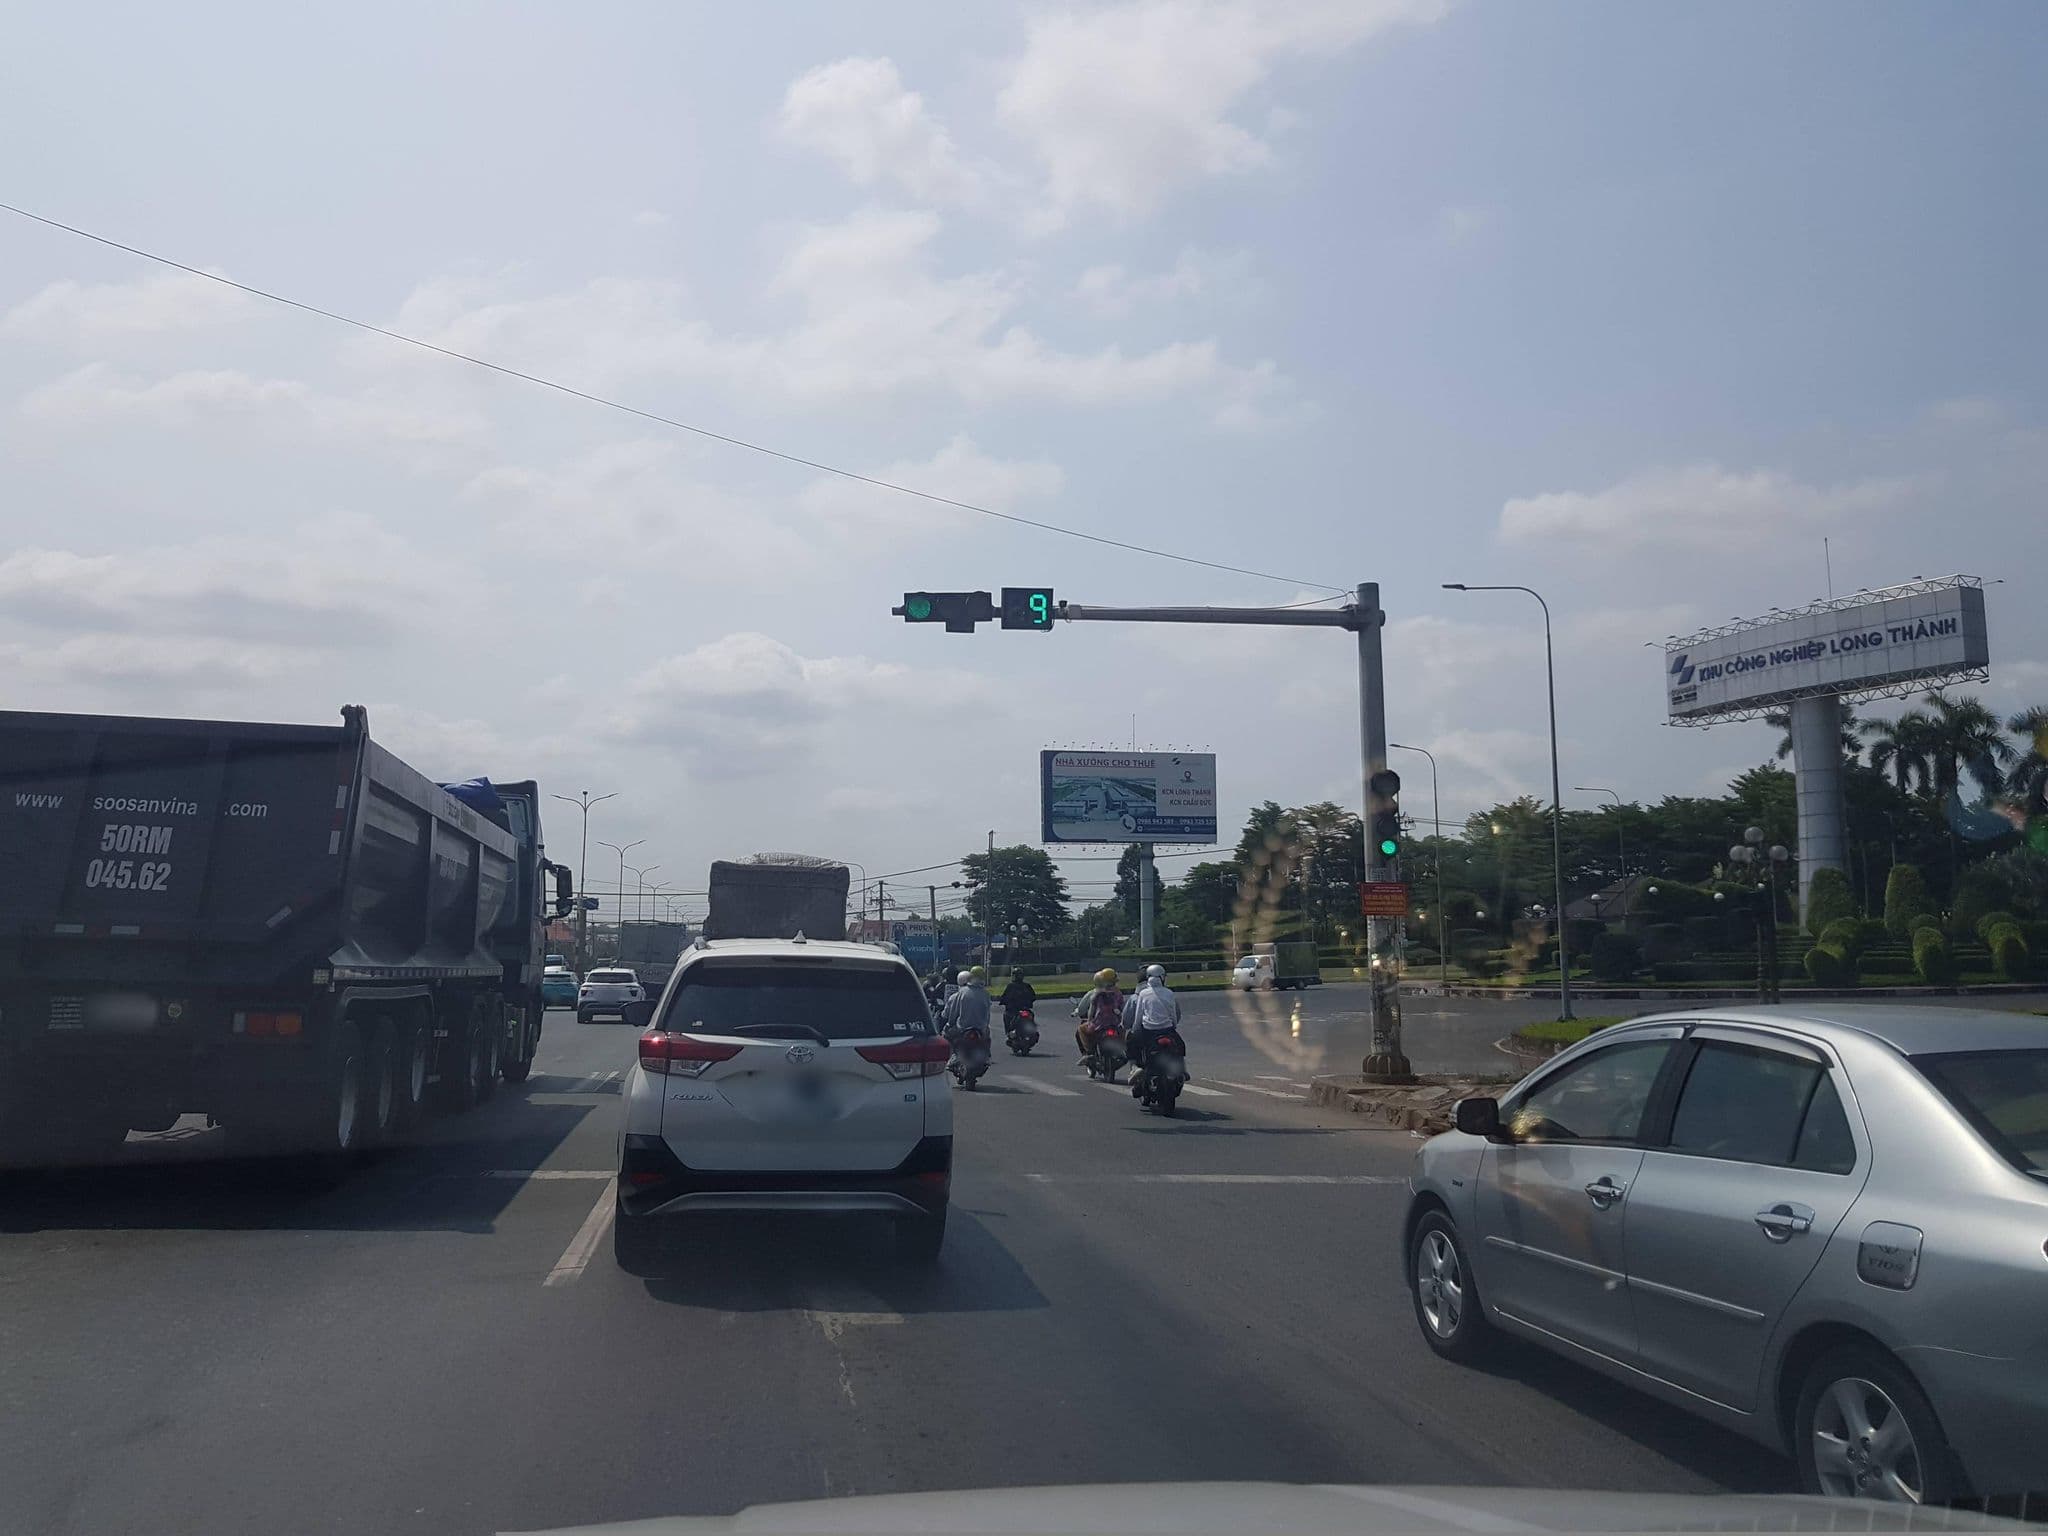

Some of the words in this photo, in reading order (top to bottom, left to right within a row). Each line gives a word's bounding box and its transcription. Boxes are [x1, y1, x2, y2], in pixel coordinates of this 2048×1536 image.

[1029, 593, 1047, 624] 9
[1699, 664, 1723, 682] KHU
[1725, 655, 1767, 675] CÔNG
[1769, 641, 1827, 666] NGHIỆP
[1830, 631, 1883, 654] LONG
[1887, 618, 1957, 643] THÀNH
[1111, 759, 1130, 767] CHO
[15, 793, 64, 809] www
[93, 797, 198, 816] soosanvina
[100, 824, 174, 855] 50RM
[85, 858, 172, 891] 045.62
